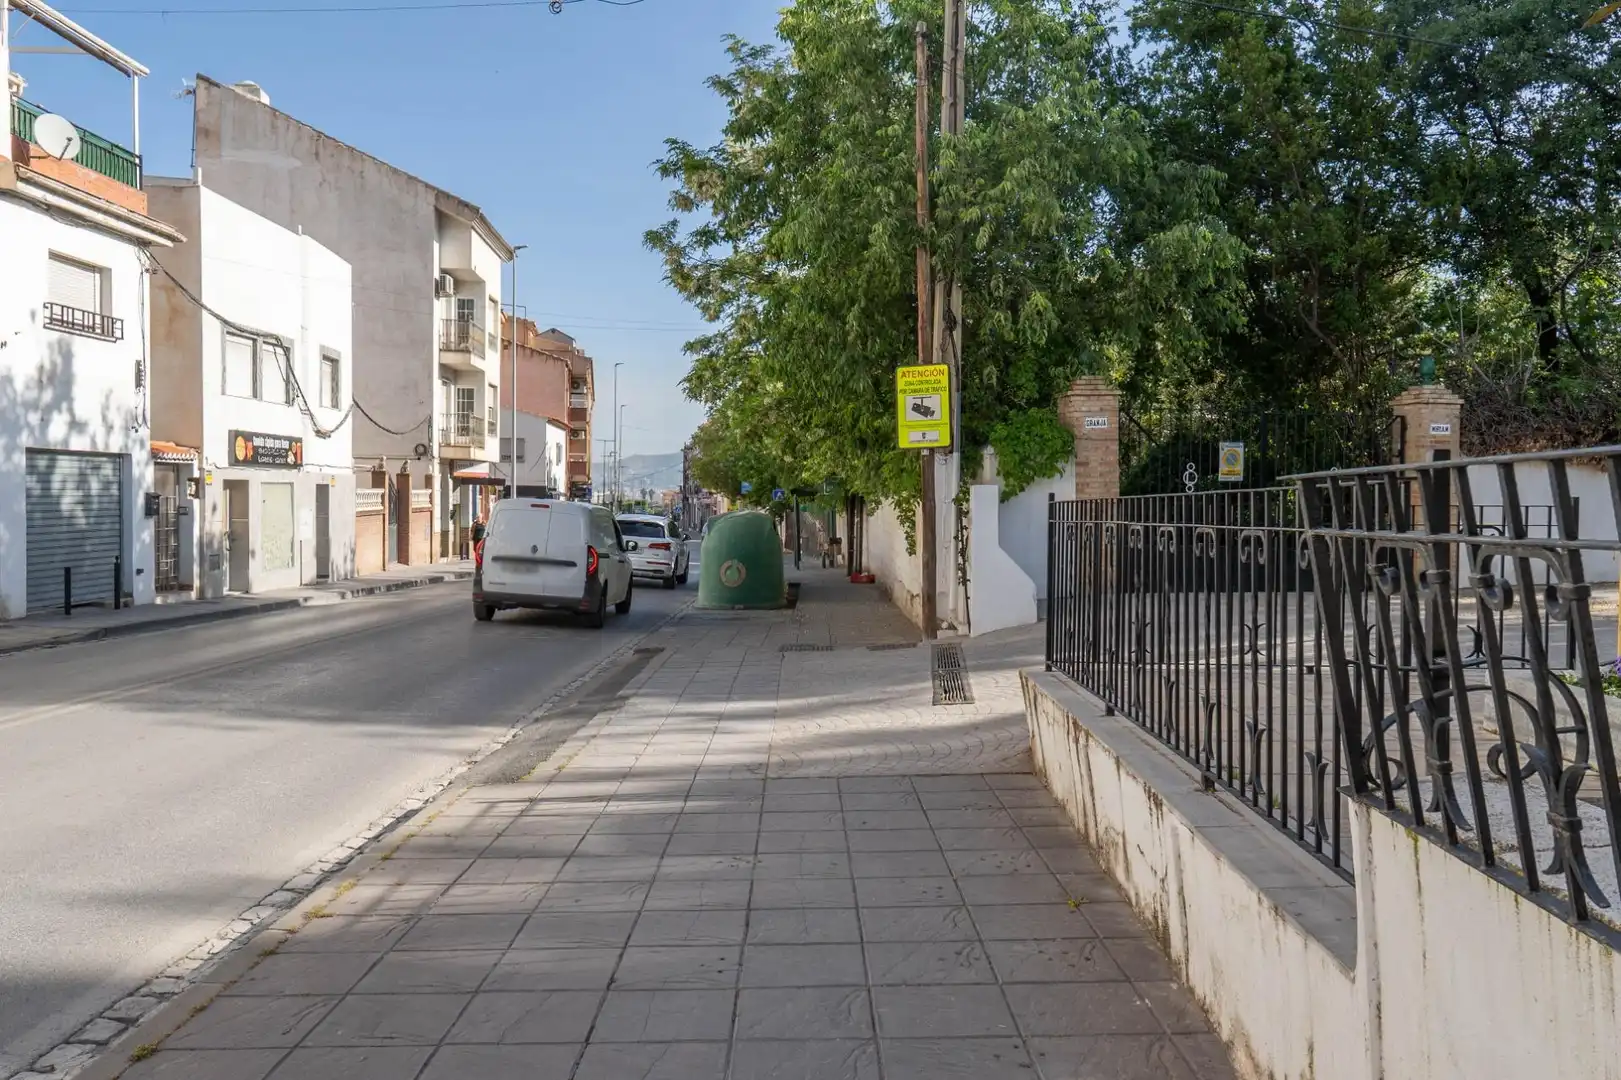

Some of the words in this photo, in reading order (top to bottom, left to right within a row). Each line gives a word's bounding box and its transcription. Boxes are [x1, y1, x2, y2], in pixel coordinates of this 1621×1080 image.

[901, 367, 945, 378] ATENCIÓN
[925, 386, 931, 394] DE
[1086, 419, 1106, 427] GRANJA
